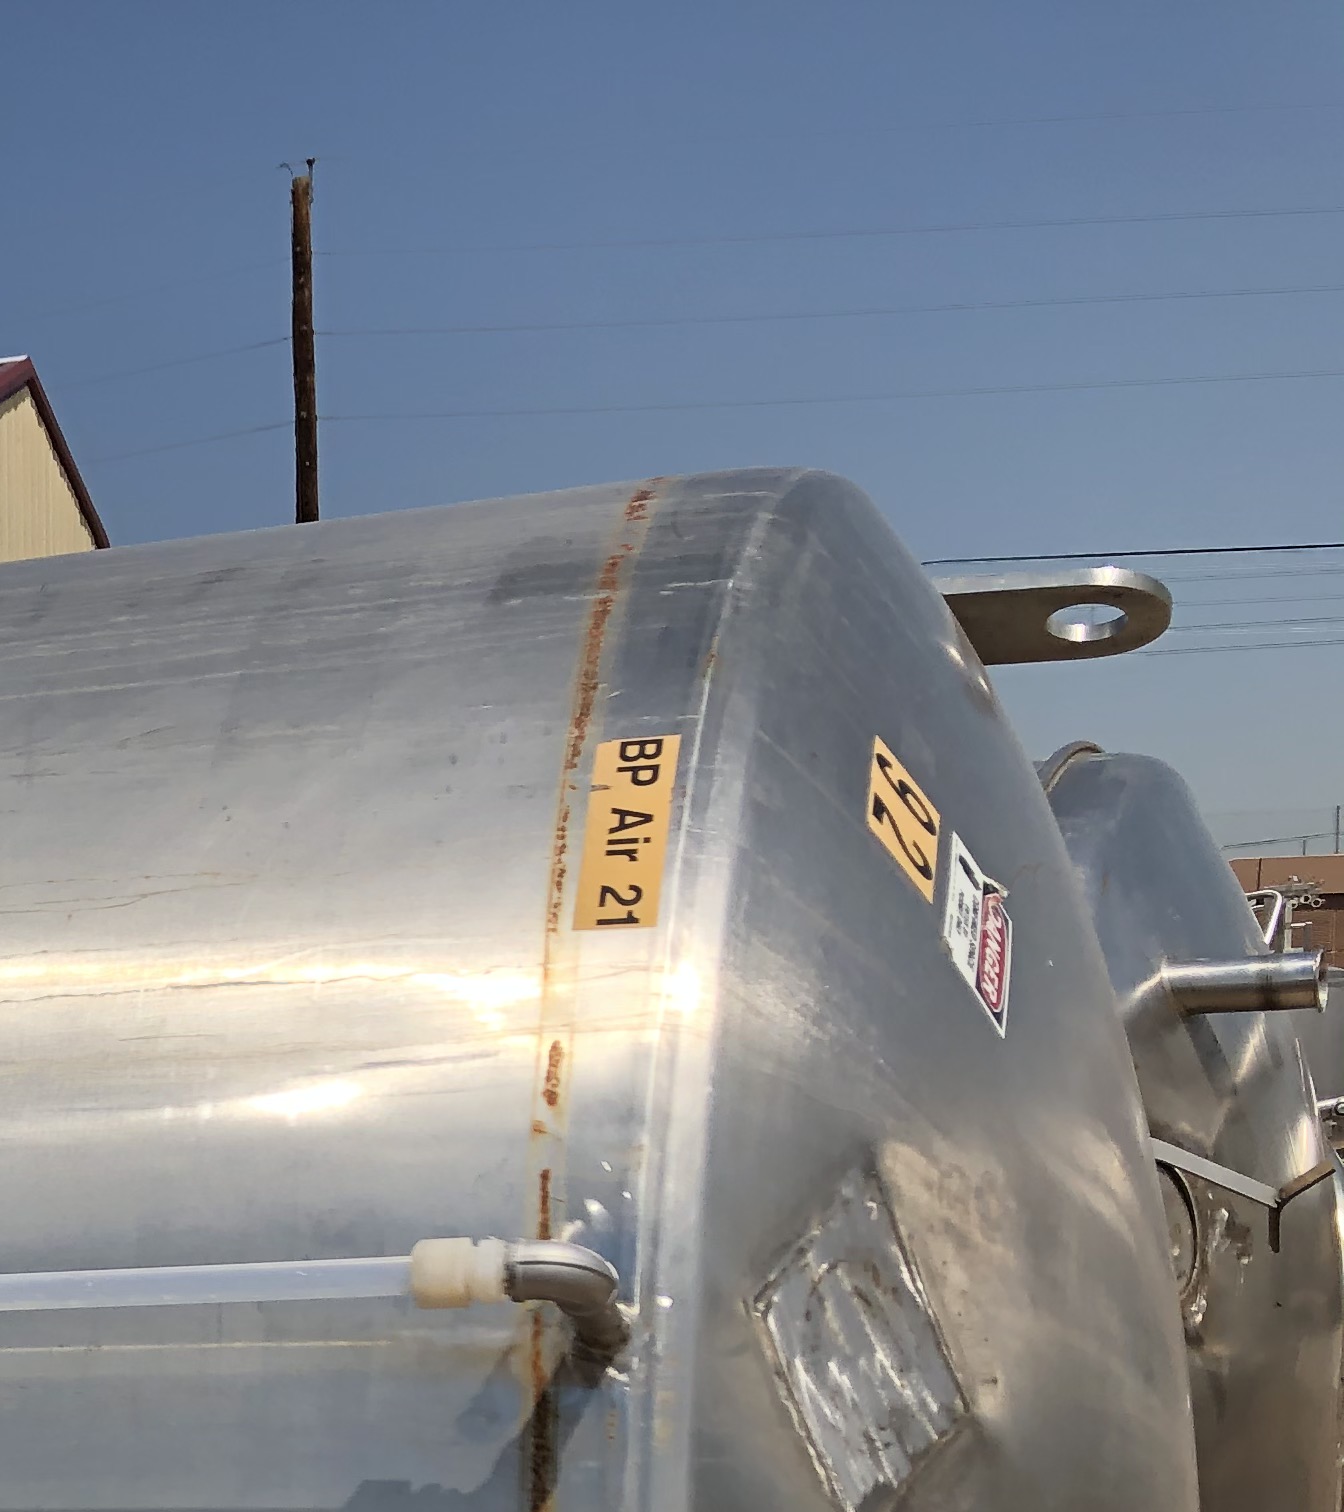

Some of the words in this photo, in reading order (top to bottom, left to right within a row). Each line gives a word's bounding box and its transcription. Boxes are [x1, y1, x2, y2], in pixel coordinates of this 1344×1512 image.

[616, 738, 663, 787] BP
[605, 807, 654, 862] Air
[873, 753, 937, 881] 92
[596, 884, 643, 926] 21
[982, 901, 1003, 1004] DANGER
